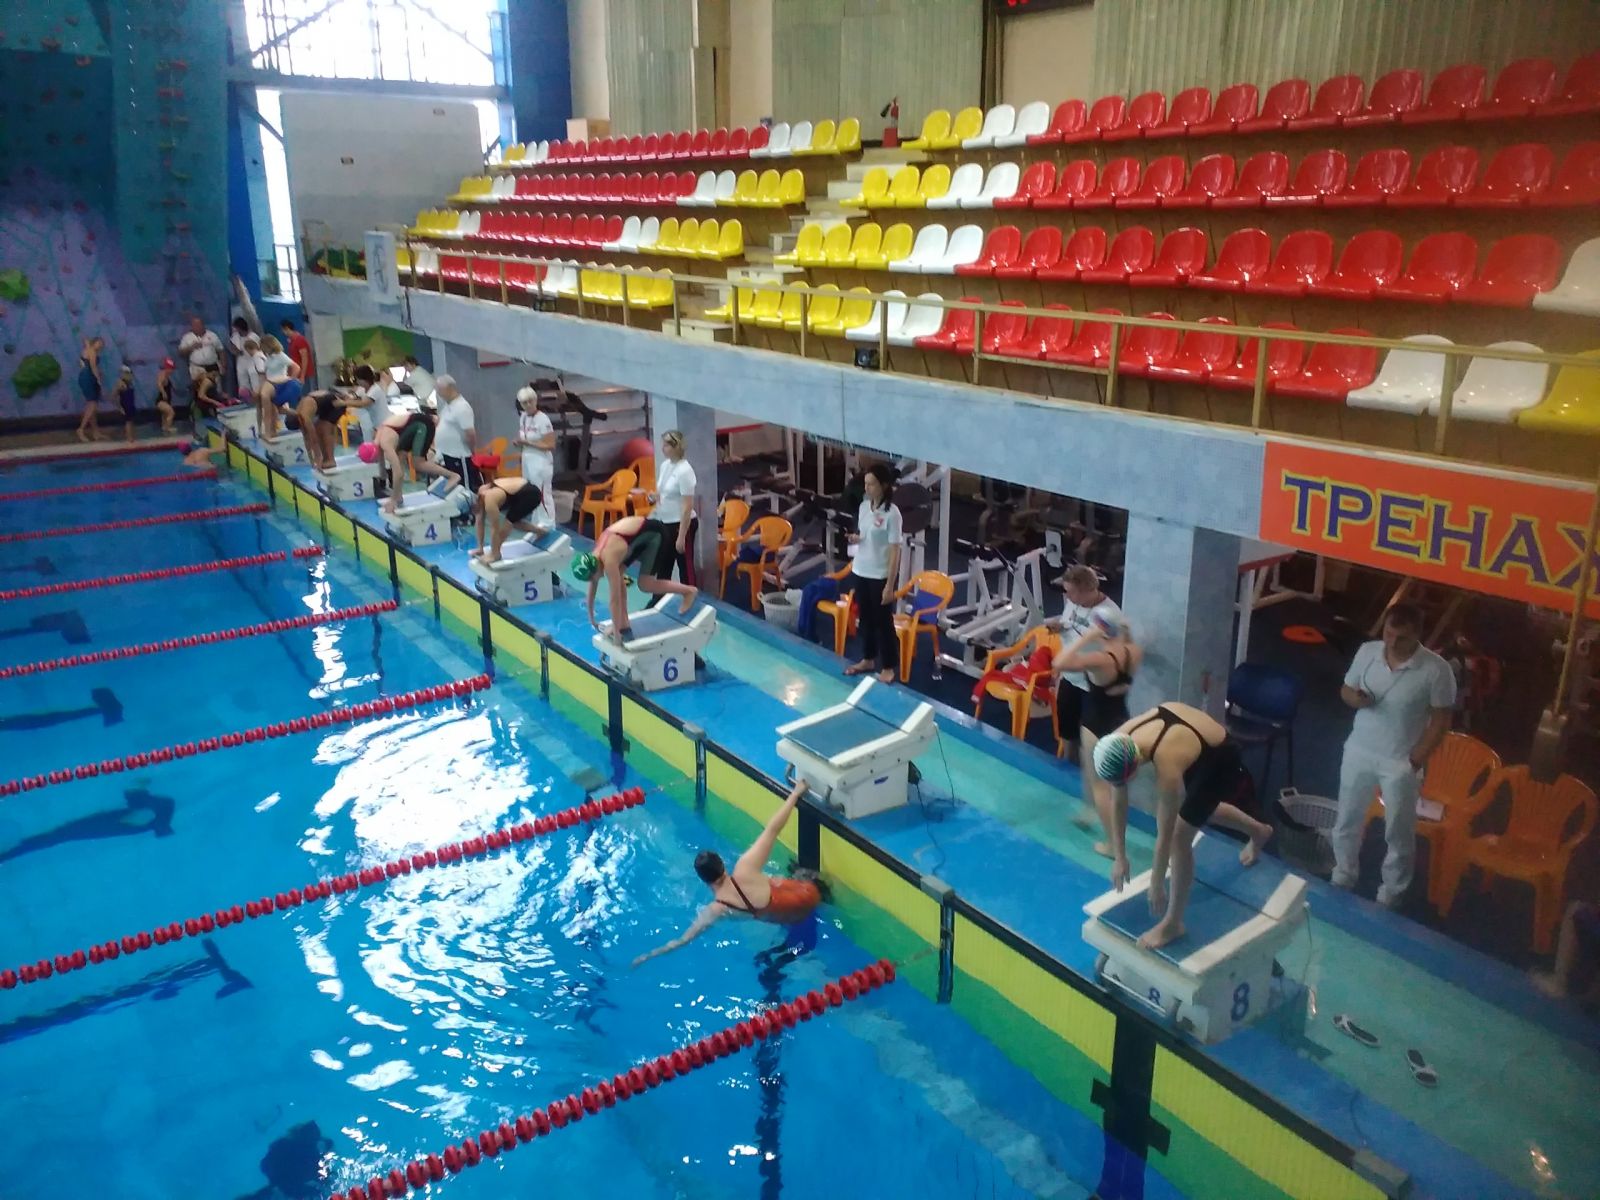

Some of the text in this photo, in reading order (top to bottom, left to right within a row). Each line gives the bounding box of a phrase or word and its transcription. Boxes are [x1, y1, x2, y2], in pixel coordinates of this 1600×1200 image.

[294, 447, 305, 464] 2
[353, 481, 364, 497] 3
[424, 523, 438, 541] 4
[524, 580, 539, 601] 5
[663, 657, 679, 682] 6
[1231, 982, 1250, 1022] 8
